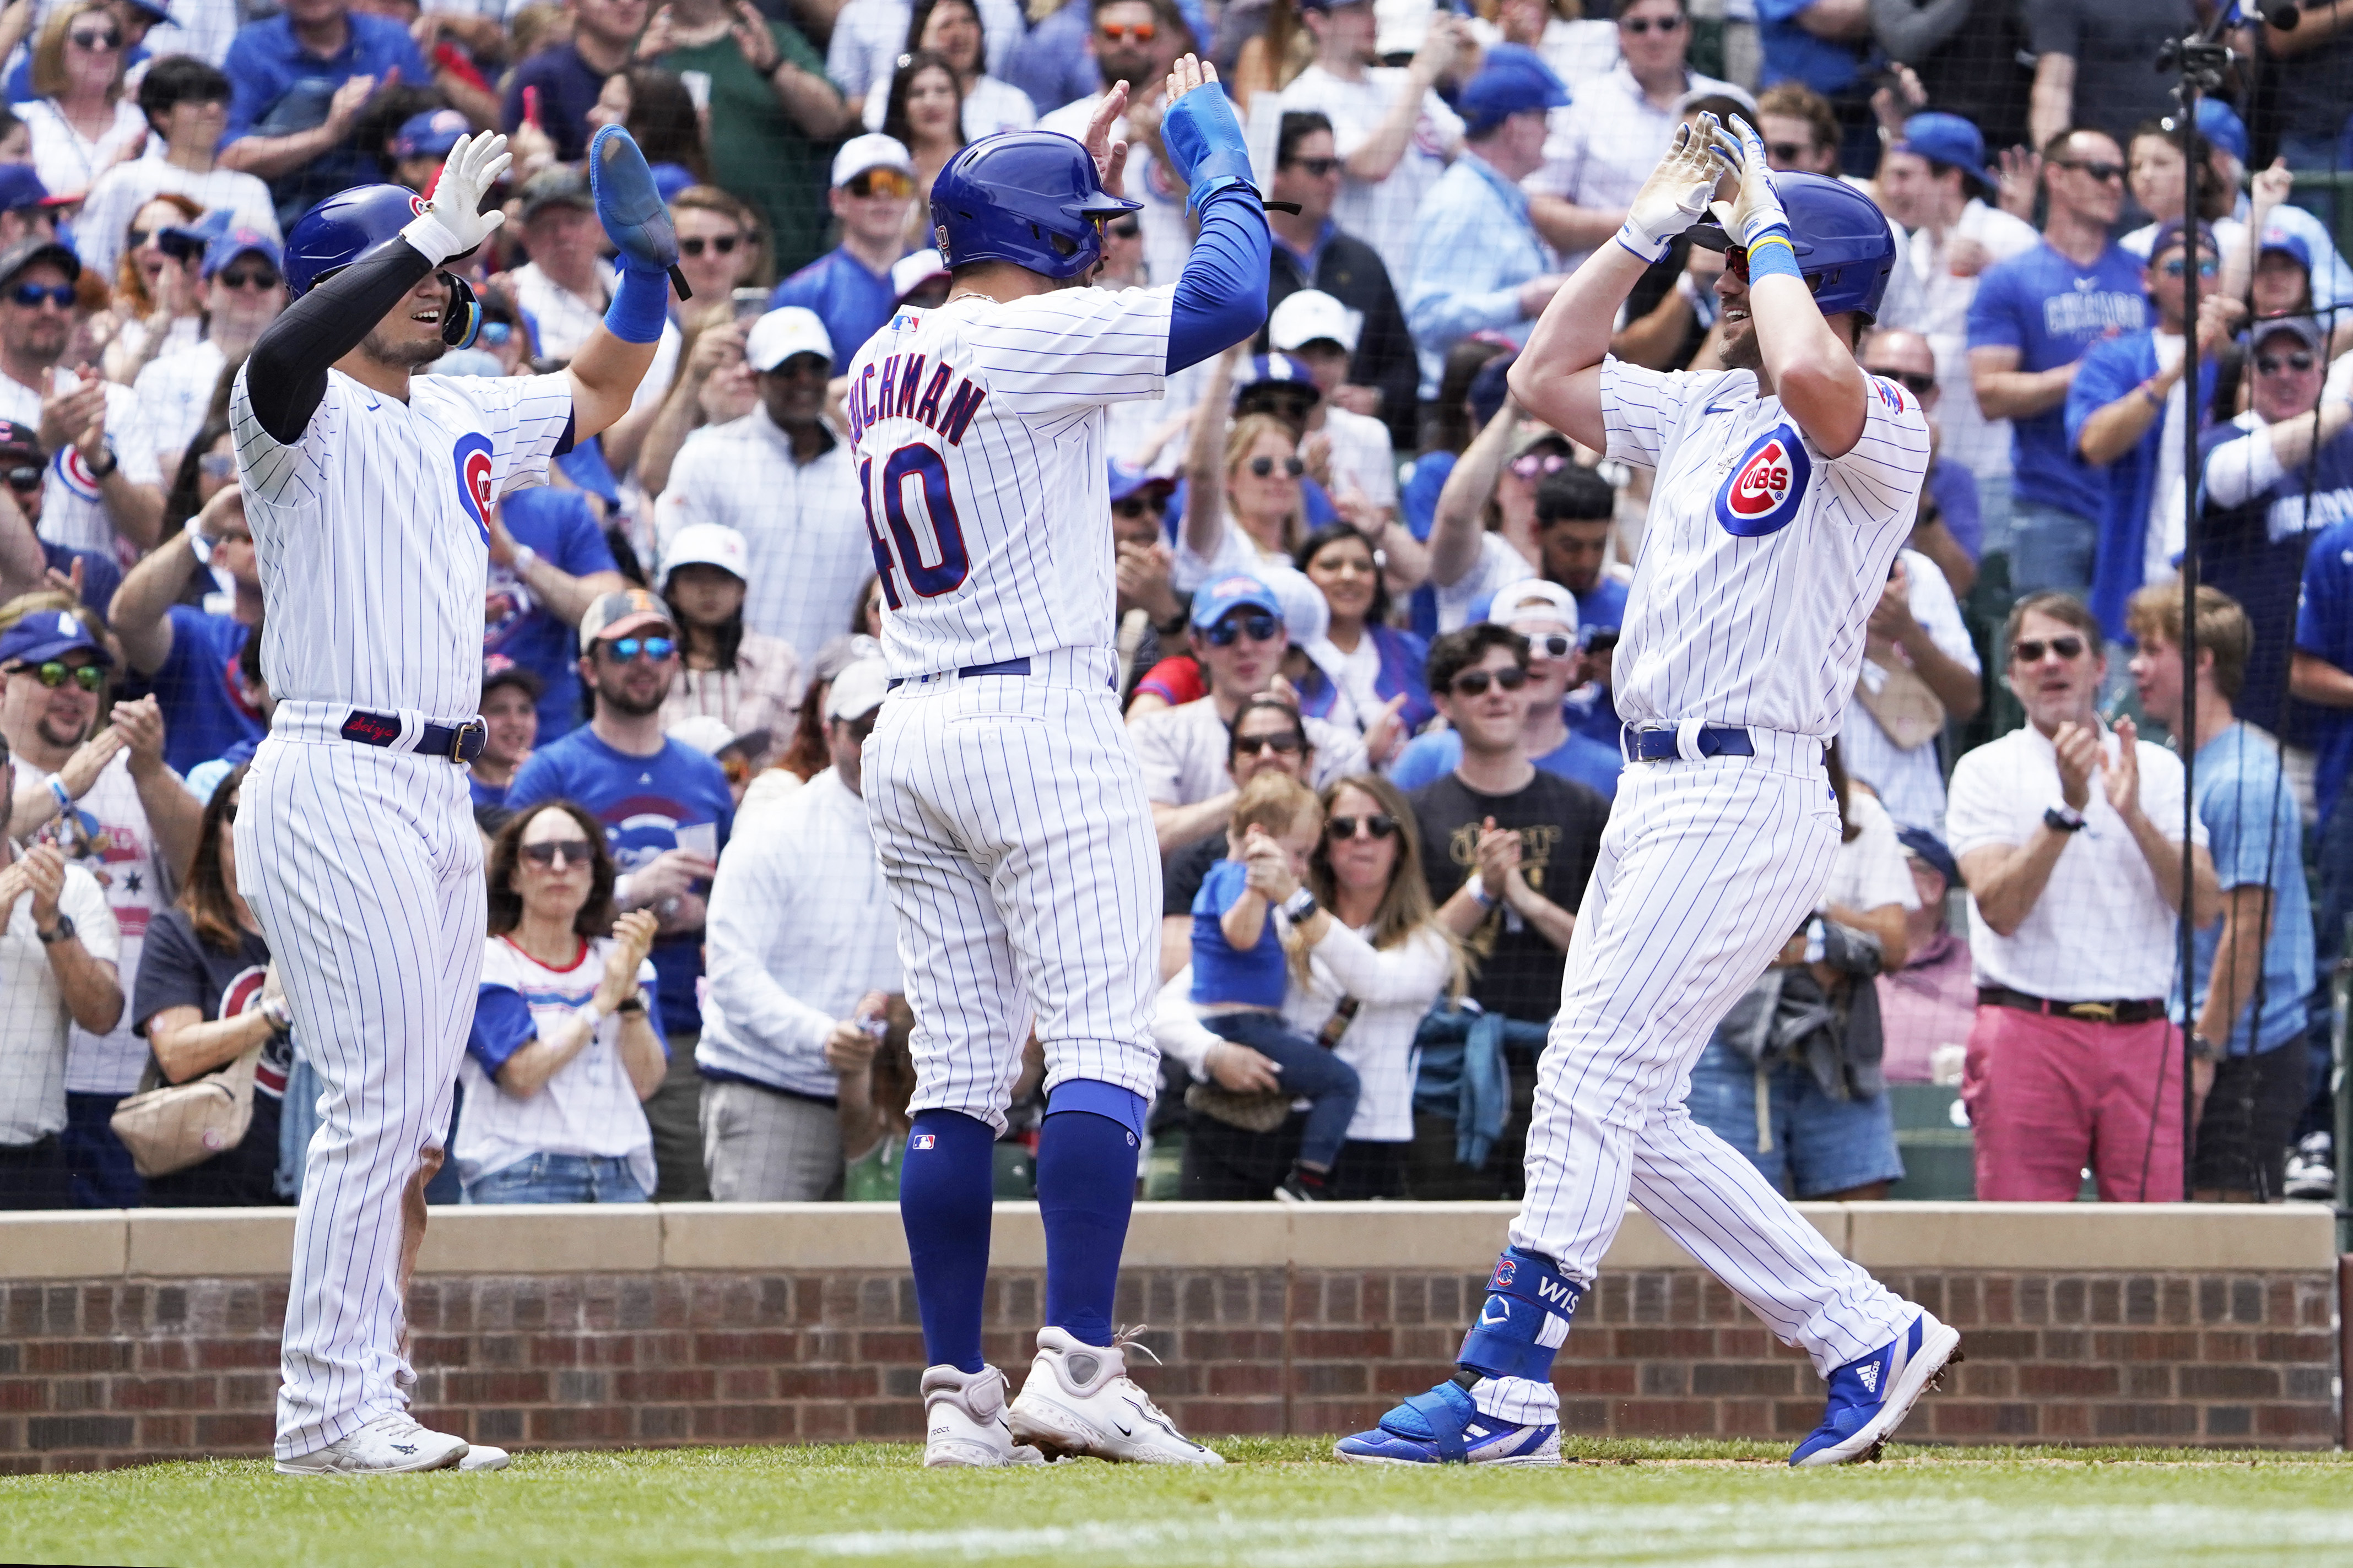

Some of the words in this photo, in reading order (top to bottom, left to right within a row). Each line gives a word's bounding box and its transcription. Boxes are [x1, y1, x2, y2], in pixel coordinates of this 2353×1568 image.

[848, 352, 986, 454] UCHMAN
[345, 717, 395, 740] Seiya
[1538, 1276, 1580, 1314] WIS
[1868, 1360, 1880, 1393] adidas
